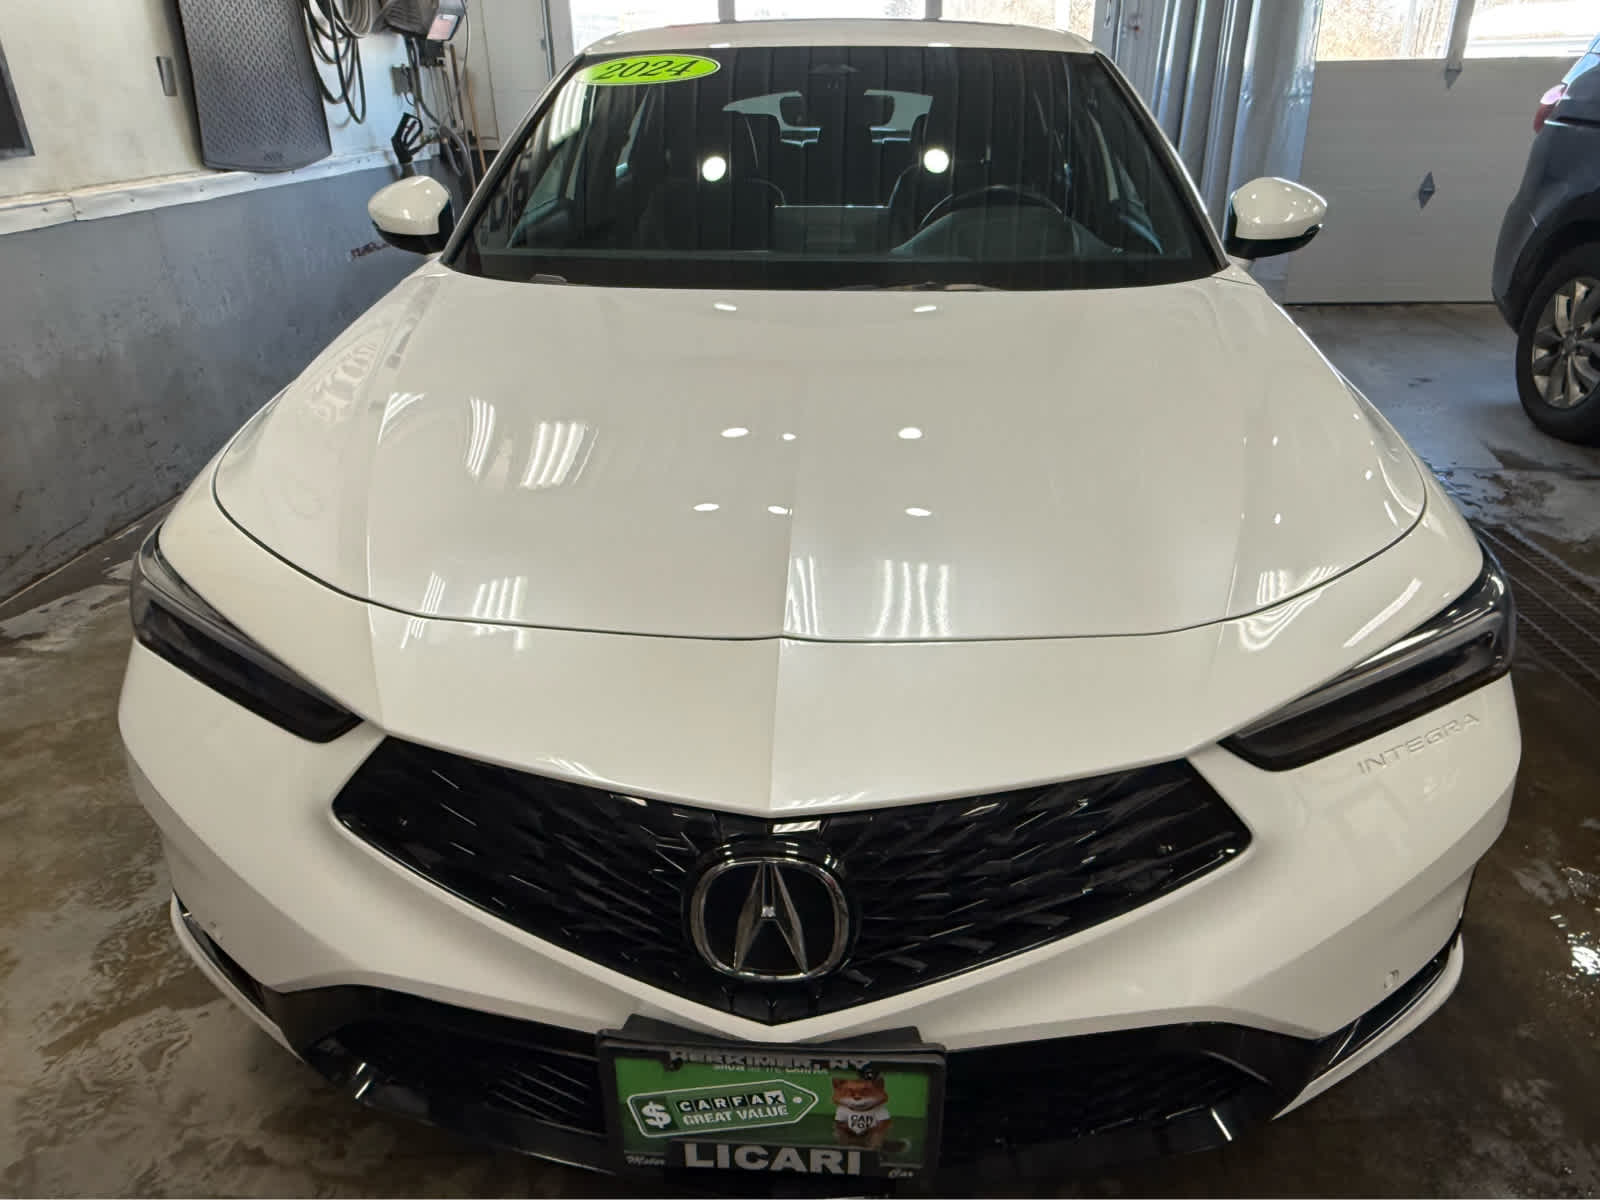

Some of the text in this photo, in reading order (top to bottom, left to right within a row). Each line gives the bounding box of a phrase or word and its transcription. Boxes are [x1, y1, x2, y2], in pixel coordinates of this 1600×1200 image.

[593, 59, 698, 80] 2024
[1357, 713, 1480, 774] INTEGRA
[678, 1089, 786, 1112] CARFAX
[682, 1104, 789, 1126] GREAT VALUE
[684, 1143, 861, 1175] LICARI
